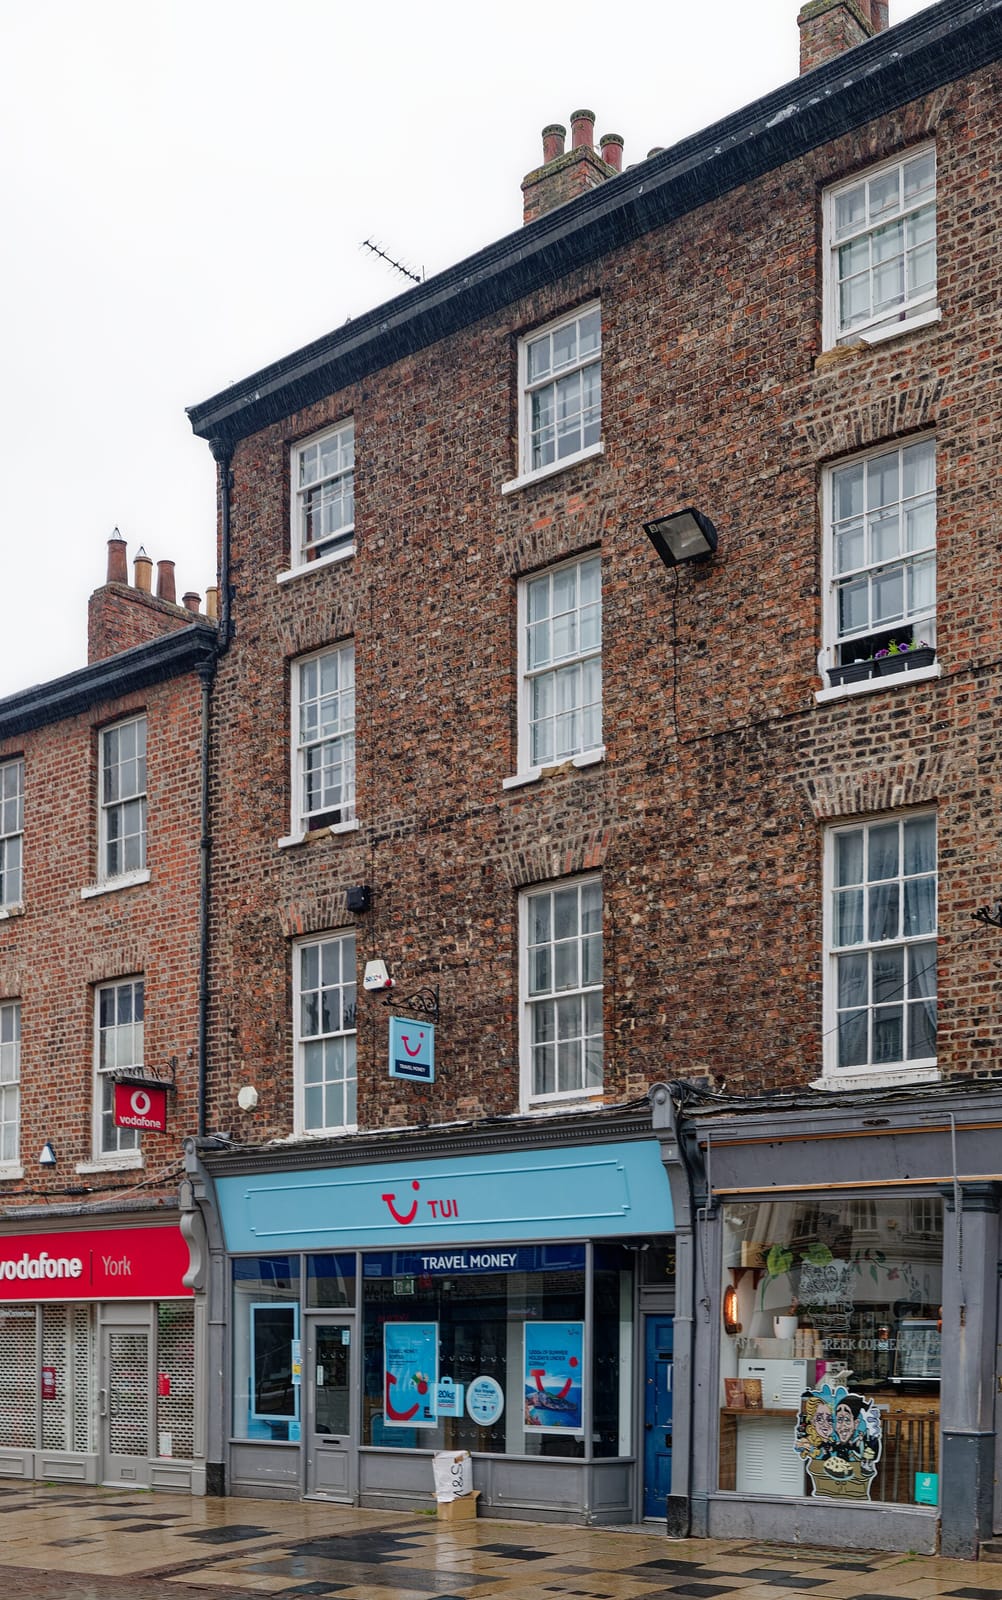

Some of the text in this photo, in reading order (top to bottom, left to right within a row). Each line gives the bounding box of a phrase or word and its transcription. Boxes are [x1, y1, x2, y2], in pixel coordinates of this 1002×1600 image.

[119, 1116, 161, 1128] vodafone
[426, 1199, 459, 1218] TUI
[101, 1255, 132, 1276] York
[421, 1253, 517, 1270] TRAVEL MONEY
[820, 1338, 856, 1350] REEK
